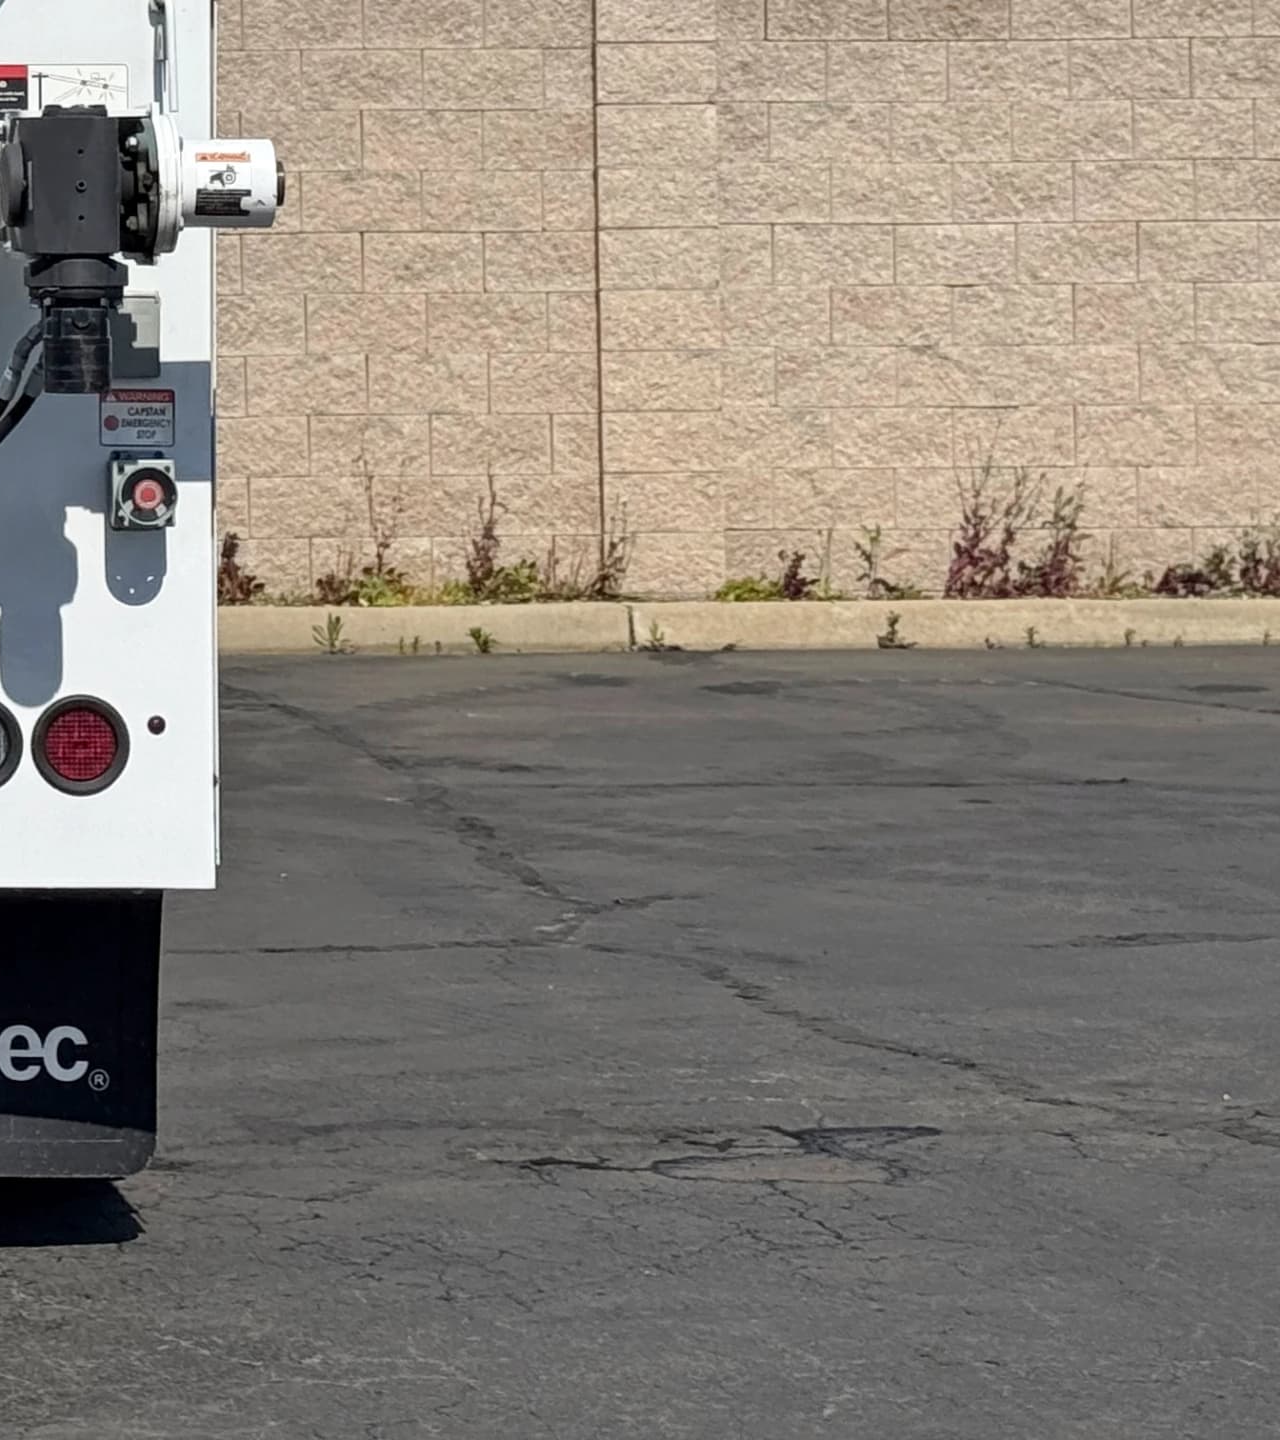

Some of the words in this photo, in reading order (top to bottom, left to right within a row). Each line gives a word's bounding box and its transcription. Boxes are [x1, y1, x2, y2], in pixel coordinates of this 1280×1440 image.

[120, 392, 170, 401] WARNING
[127, 407, 166, 416] CAPSTAN
[121, 419, 171, 428] EMERGENCY
[136, 430, 156, 440] STOP
